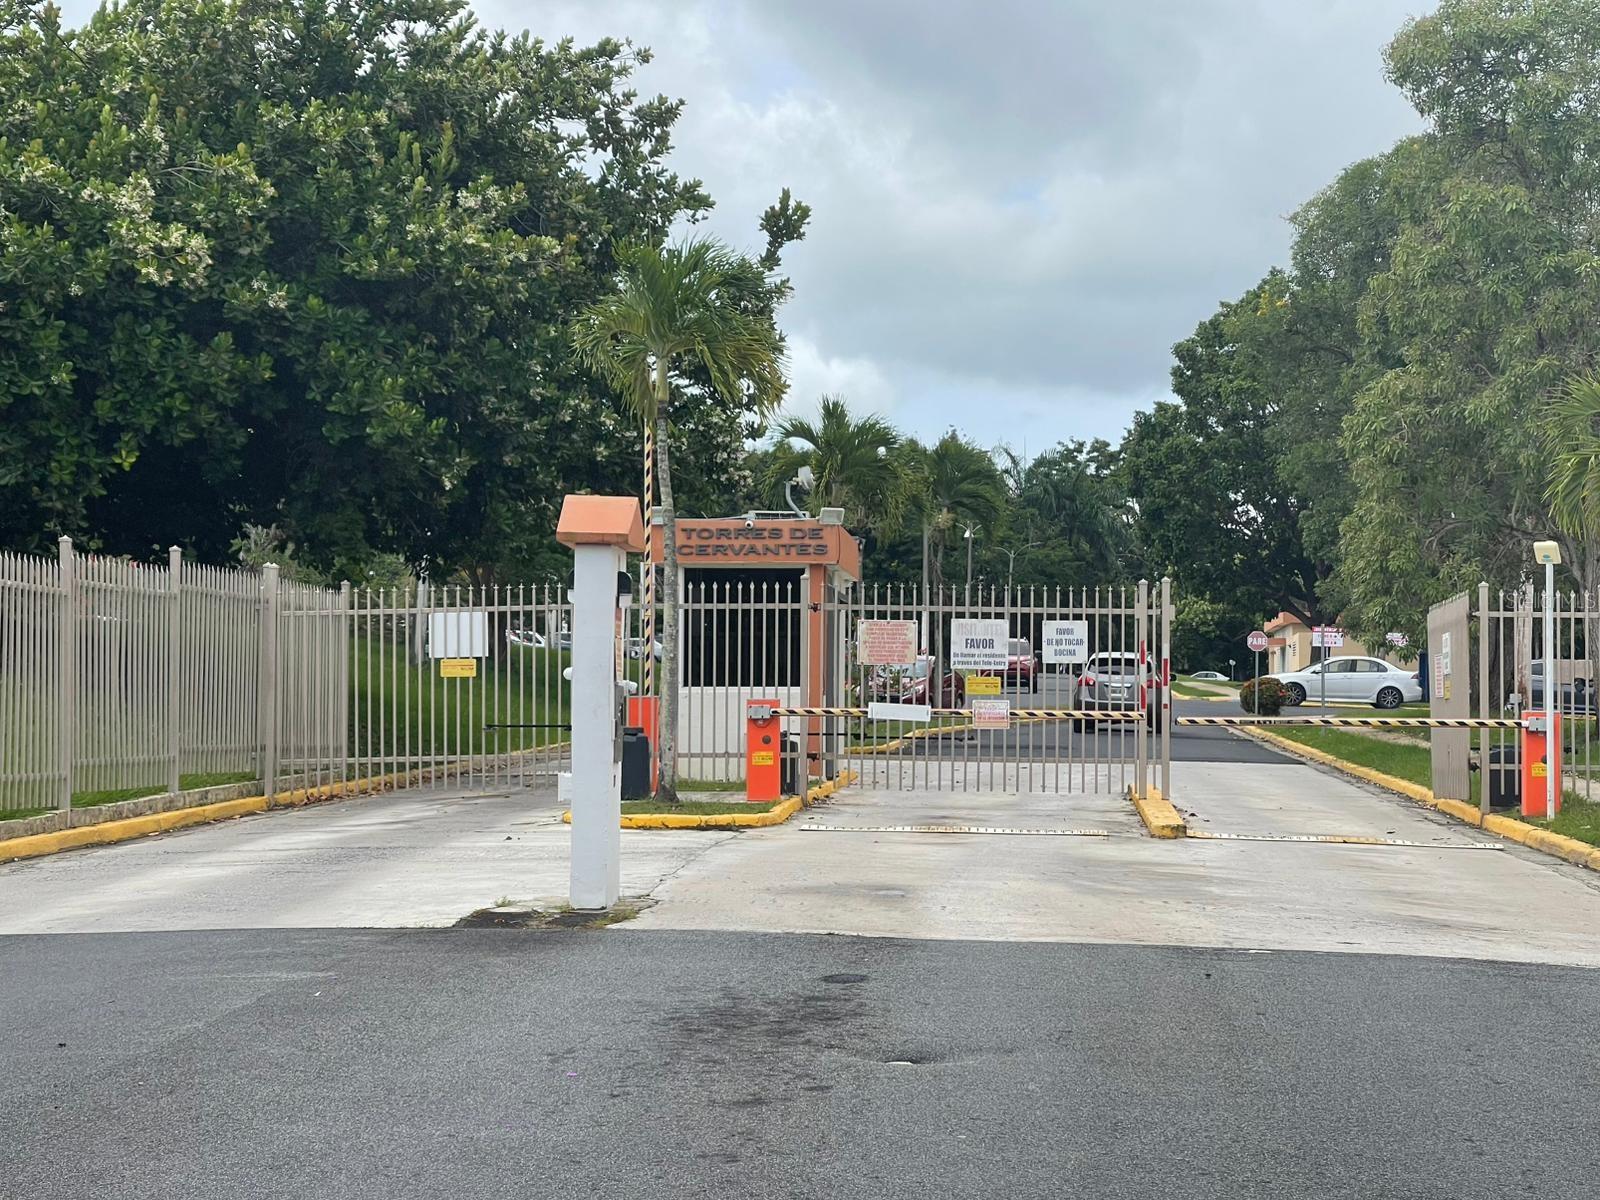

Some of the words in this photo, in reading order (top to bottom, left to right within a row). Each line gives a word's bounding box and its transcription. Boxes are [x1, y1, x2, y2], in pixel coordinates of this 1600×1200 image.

[680, 527, 783, 540] TORRES
[789, 527, 824, 540] DE
[677, 544, 828, 556] CERVANTES
[1055, 628, 1075, 636] FAVOR
[965, 638, 994, 649] FAVOR
[1064, 638, 1084, 646] TOCAR
[1248, 637, 1267, 645] PARE
[1053, 649, 1077, 657] BOCINA
